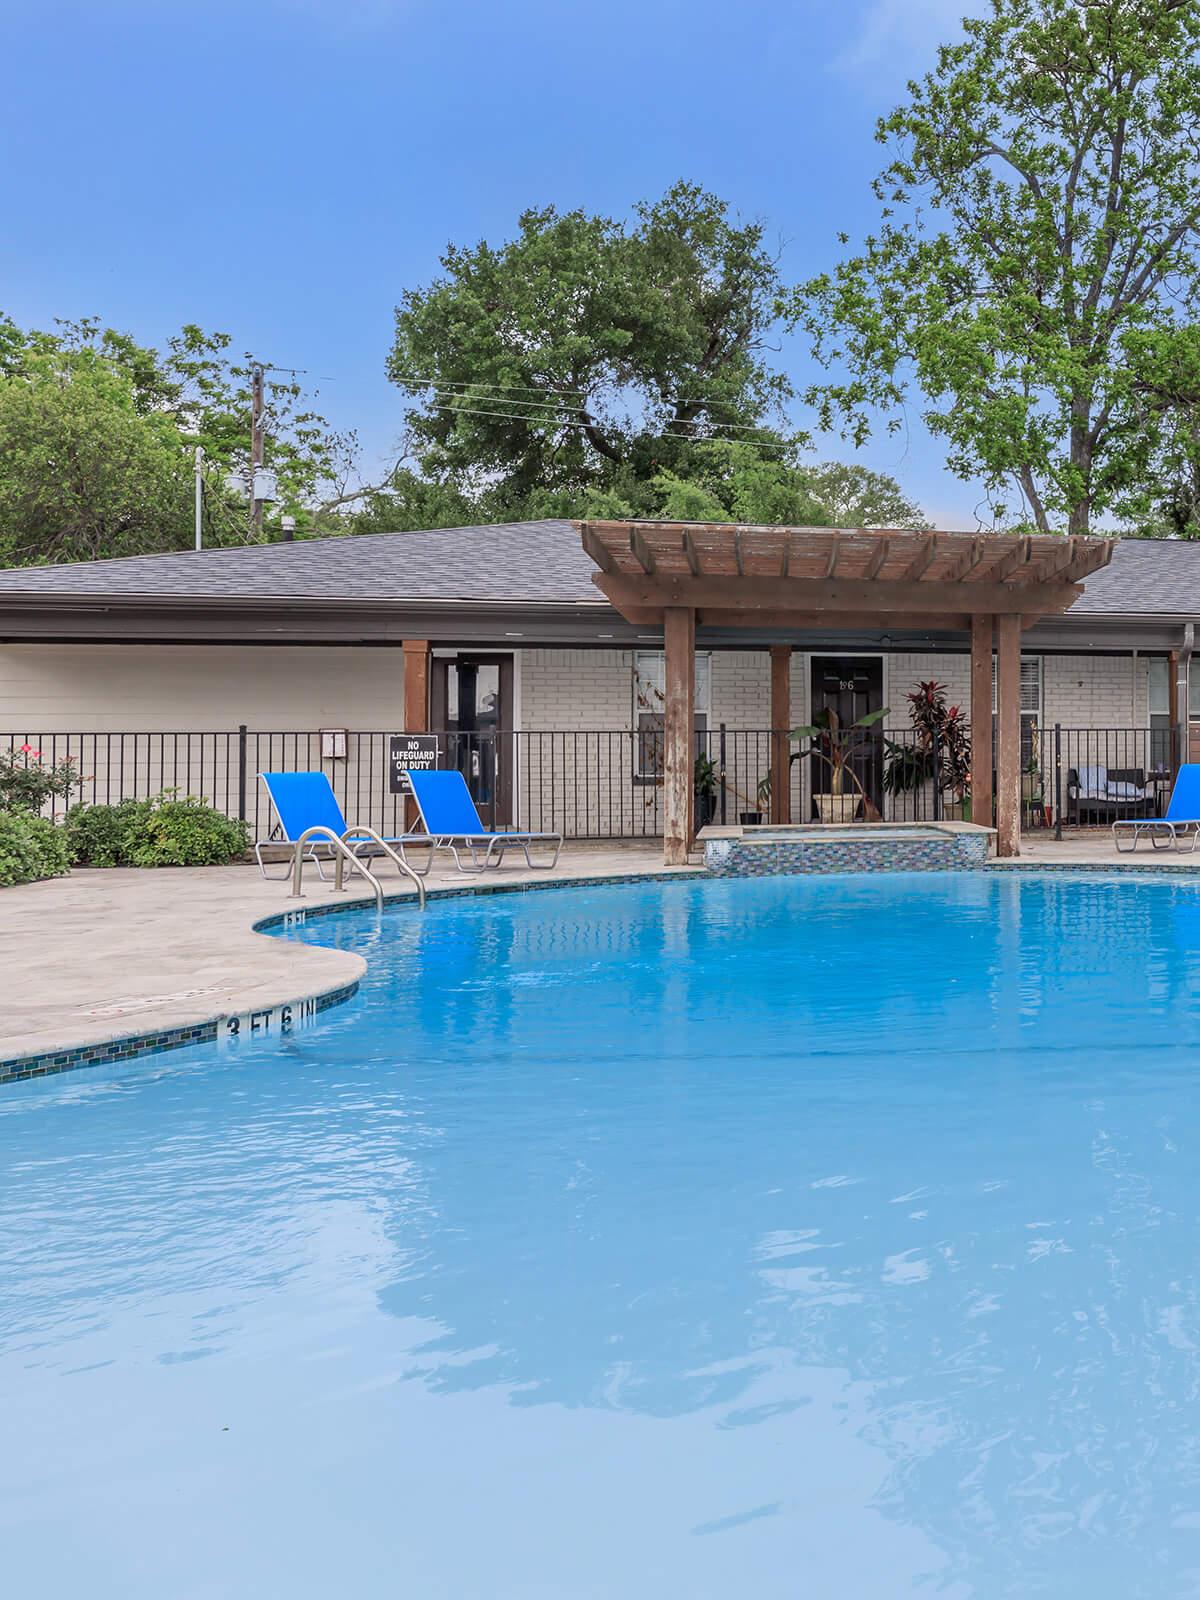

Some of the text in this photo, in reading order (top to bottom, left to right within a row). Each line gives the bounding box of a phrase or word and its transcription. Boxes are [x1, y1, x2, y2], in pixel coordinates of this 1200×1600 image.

[407, 741, 419, 750] NO
[392, 751, 434, 760] LIFEGUARD
[396, 761, 430, 770] ON DUTY
[226, 998, 314, 1036] 3 FT 6 IN
